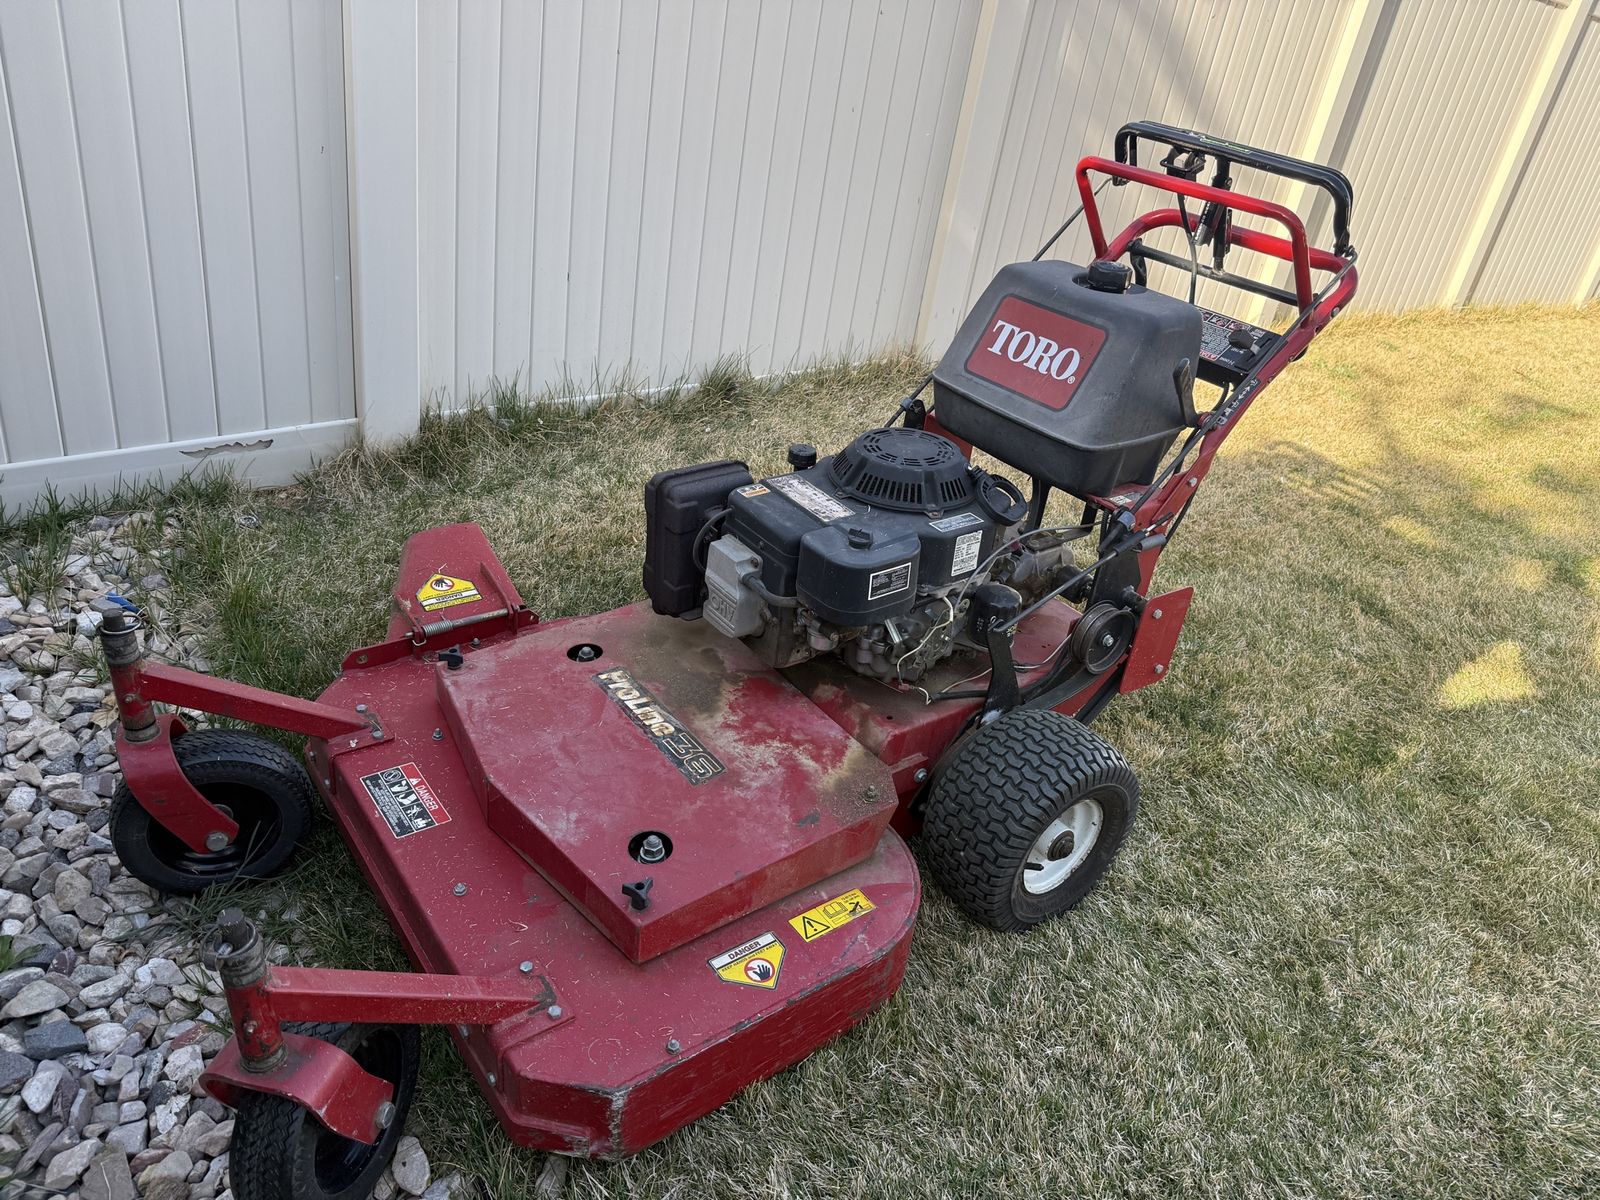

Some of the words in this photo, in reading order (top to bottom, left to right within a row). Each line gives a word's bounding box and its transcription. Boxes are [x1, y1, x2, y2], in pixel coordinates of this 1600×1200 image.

[987, 320, 1080, 381] TORO
[662, 732, 722, 779] 36
[415, 785, 439, 811] DANGER
[728, 941, 762, 960] DANGER
